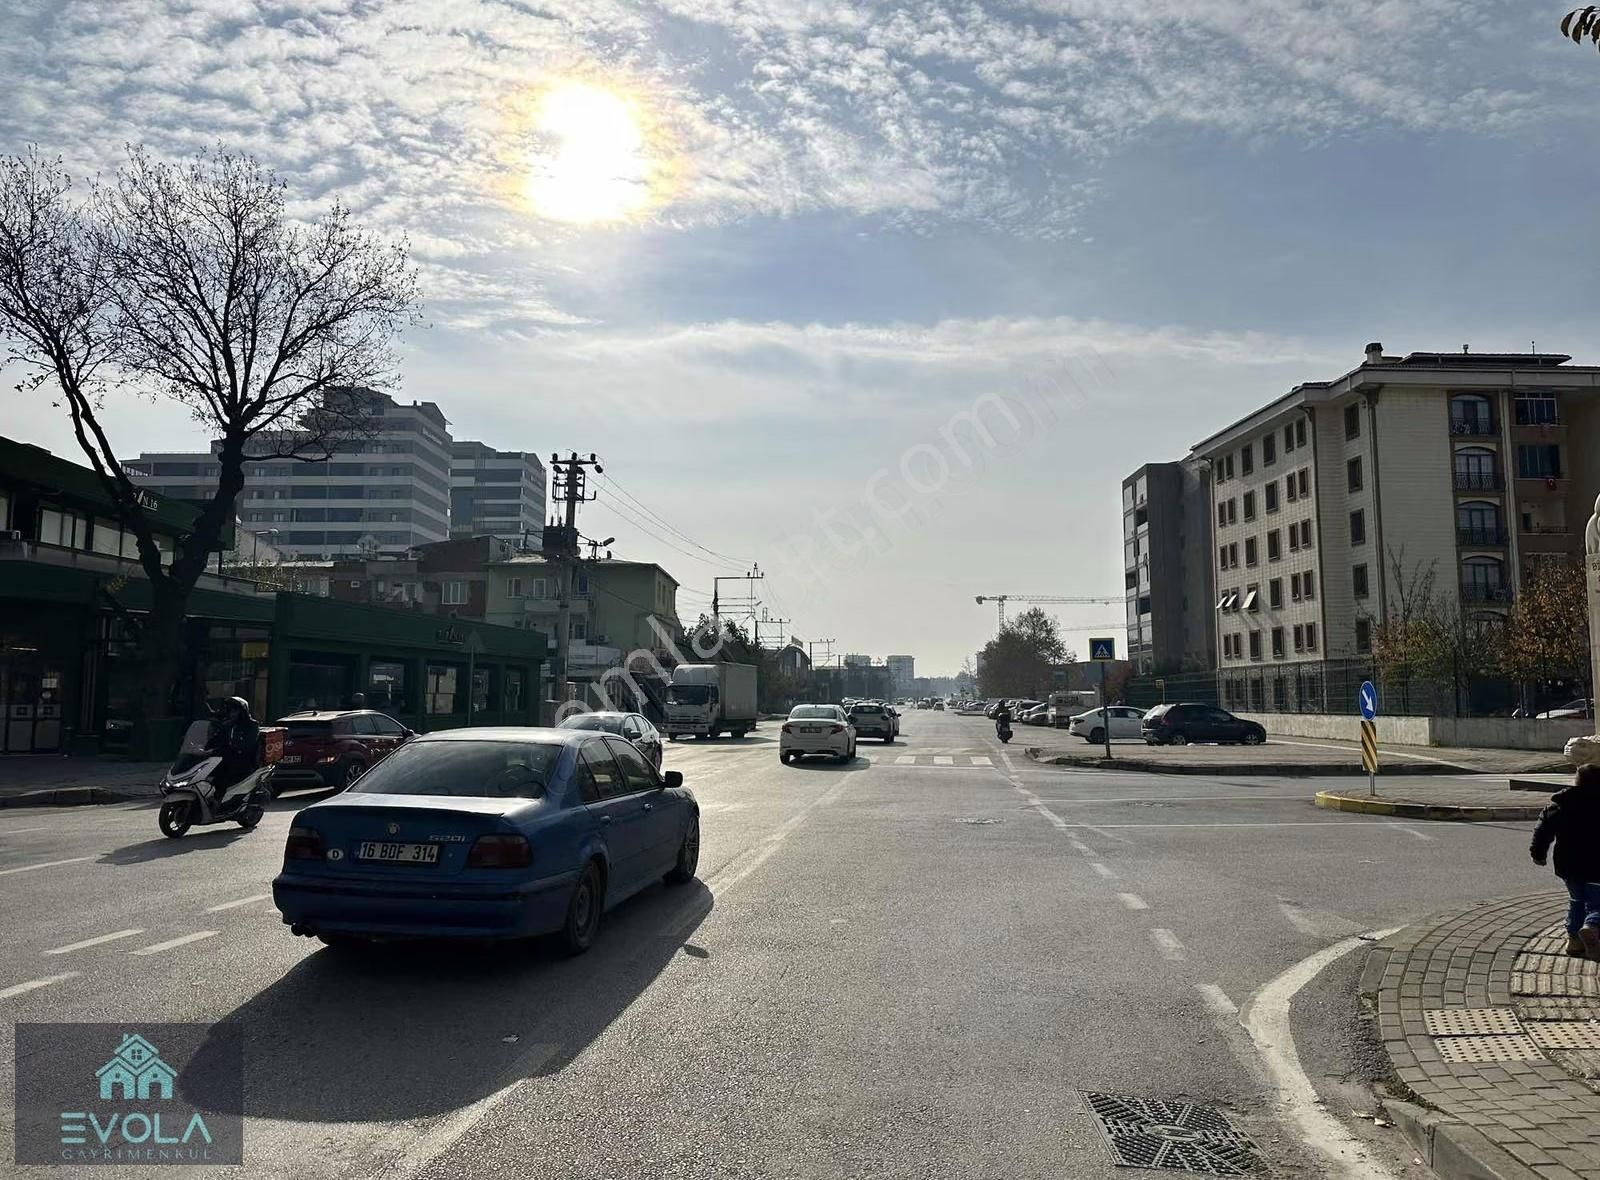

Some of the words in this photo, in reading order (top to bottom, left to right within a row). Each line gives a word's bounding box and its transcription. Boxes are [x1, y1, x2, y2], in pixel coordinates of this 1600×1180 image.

[362, 842, 375, 857] 16
[380, 843, 403, 859] BDF
[412, 845, 436, 861] 314
